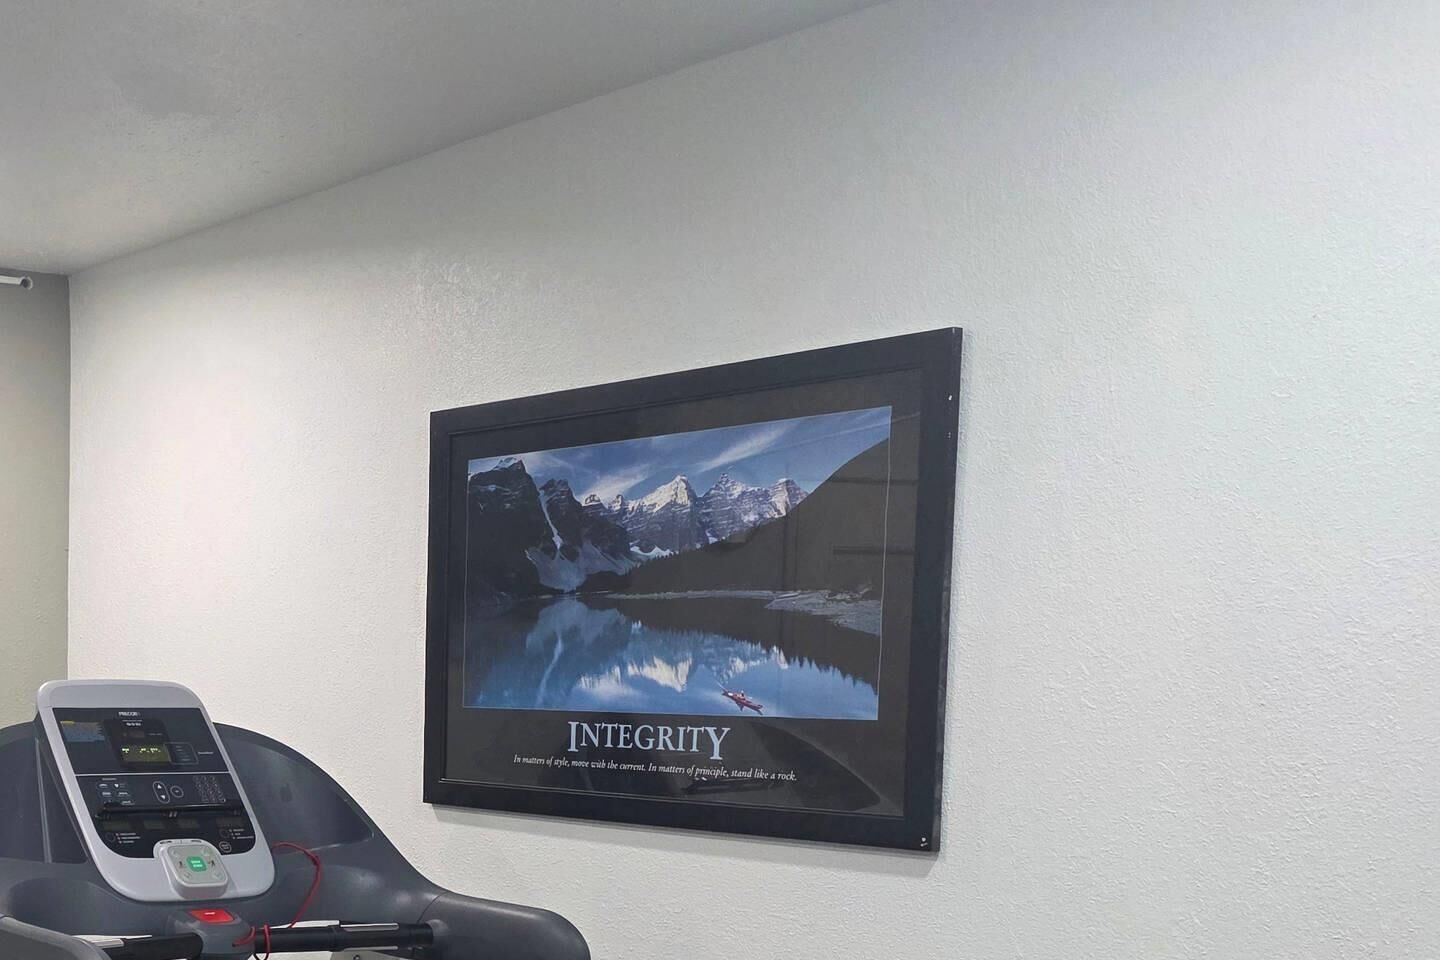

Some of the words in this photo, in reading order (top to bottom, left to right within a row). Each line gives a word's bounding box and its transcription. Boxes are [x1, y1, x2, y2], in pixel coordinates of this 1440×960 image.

[568, 721, 731, 760] INTEGRITY
[513, 754, 521, 763] In
[522, 757, 545, 765] matters
[546, 756, 554, 767] of
[554, 756, 570, 768] style,
[571, 760, 589, 768] move
[591, 759, 606, 769] with
[607, 760, 618, 770] the
[620, 763, 646, 772] current.
[648, 762, 657, 772] In
[658, 765, 685, 774] matters
[686, 764, 696, 776] of
[695, 766, 729, 778] principle,
[731, 768, 752, 778] stand
[754, 768, 769, 779] like
[777, 770, 798, 781] rock.
